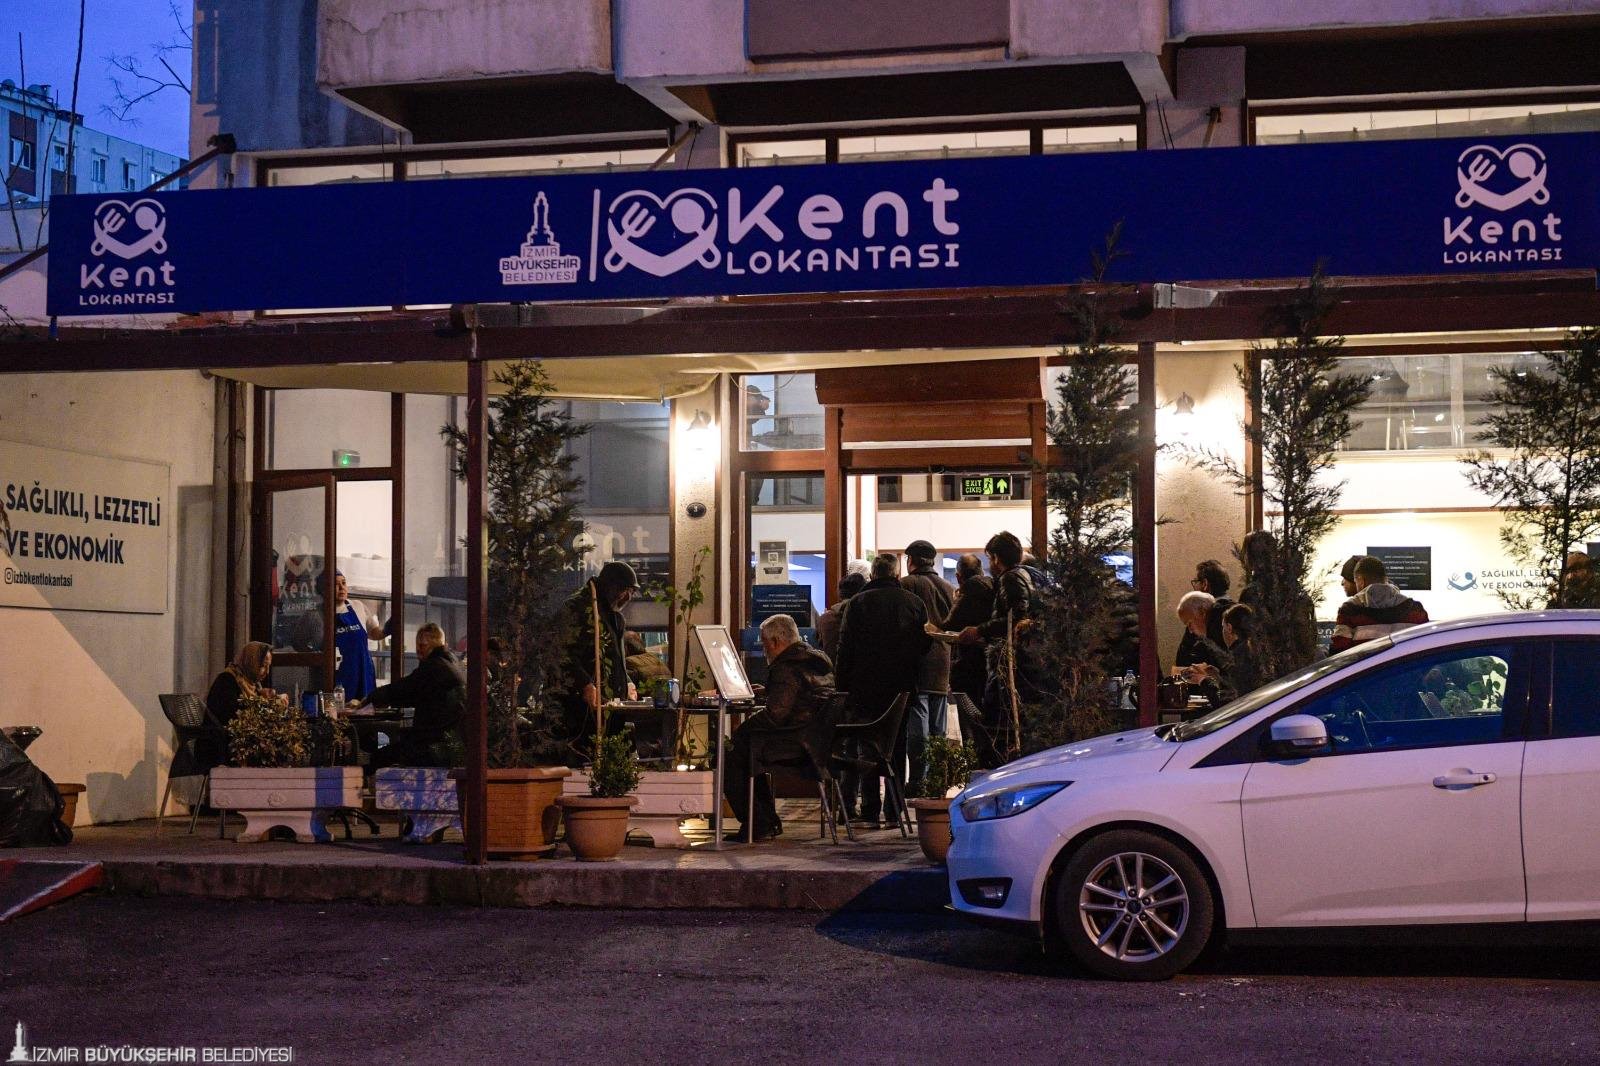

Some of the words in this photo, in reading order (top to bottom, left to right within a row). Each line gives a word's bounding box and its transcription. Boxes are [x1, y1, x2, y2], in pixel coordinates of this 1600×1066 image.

[727, 177, 960, 244] Kent
[1443, 212, 1562, 245] Kent
[726, 243, 960, 275] LOKANTASI
[1443, 248, 1562, 264] LOKANTASI
[80, 260, 176, 289] Kent
[79, 292, 176, 306] LOKANTASI
[965, 479, 982, 487] EXIT
[5, 480, 89, 523] SAĞLIKLI,
[94, 495, 161, 526] LEZZETLİ
[6, 529, 29, 558] VE
[34, 533, 124, 564] EKONOMİK
[539, 525, 650, 554] ent
[13, 570, 73, 587] izbbkentlokantasi
